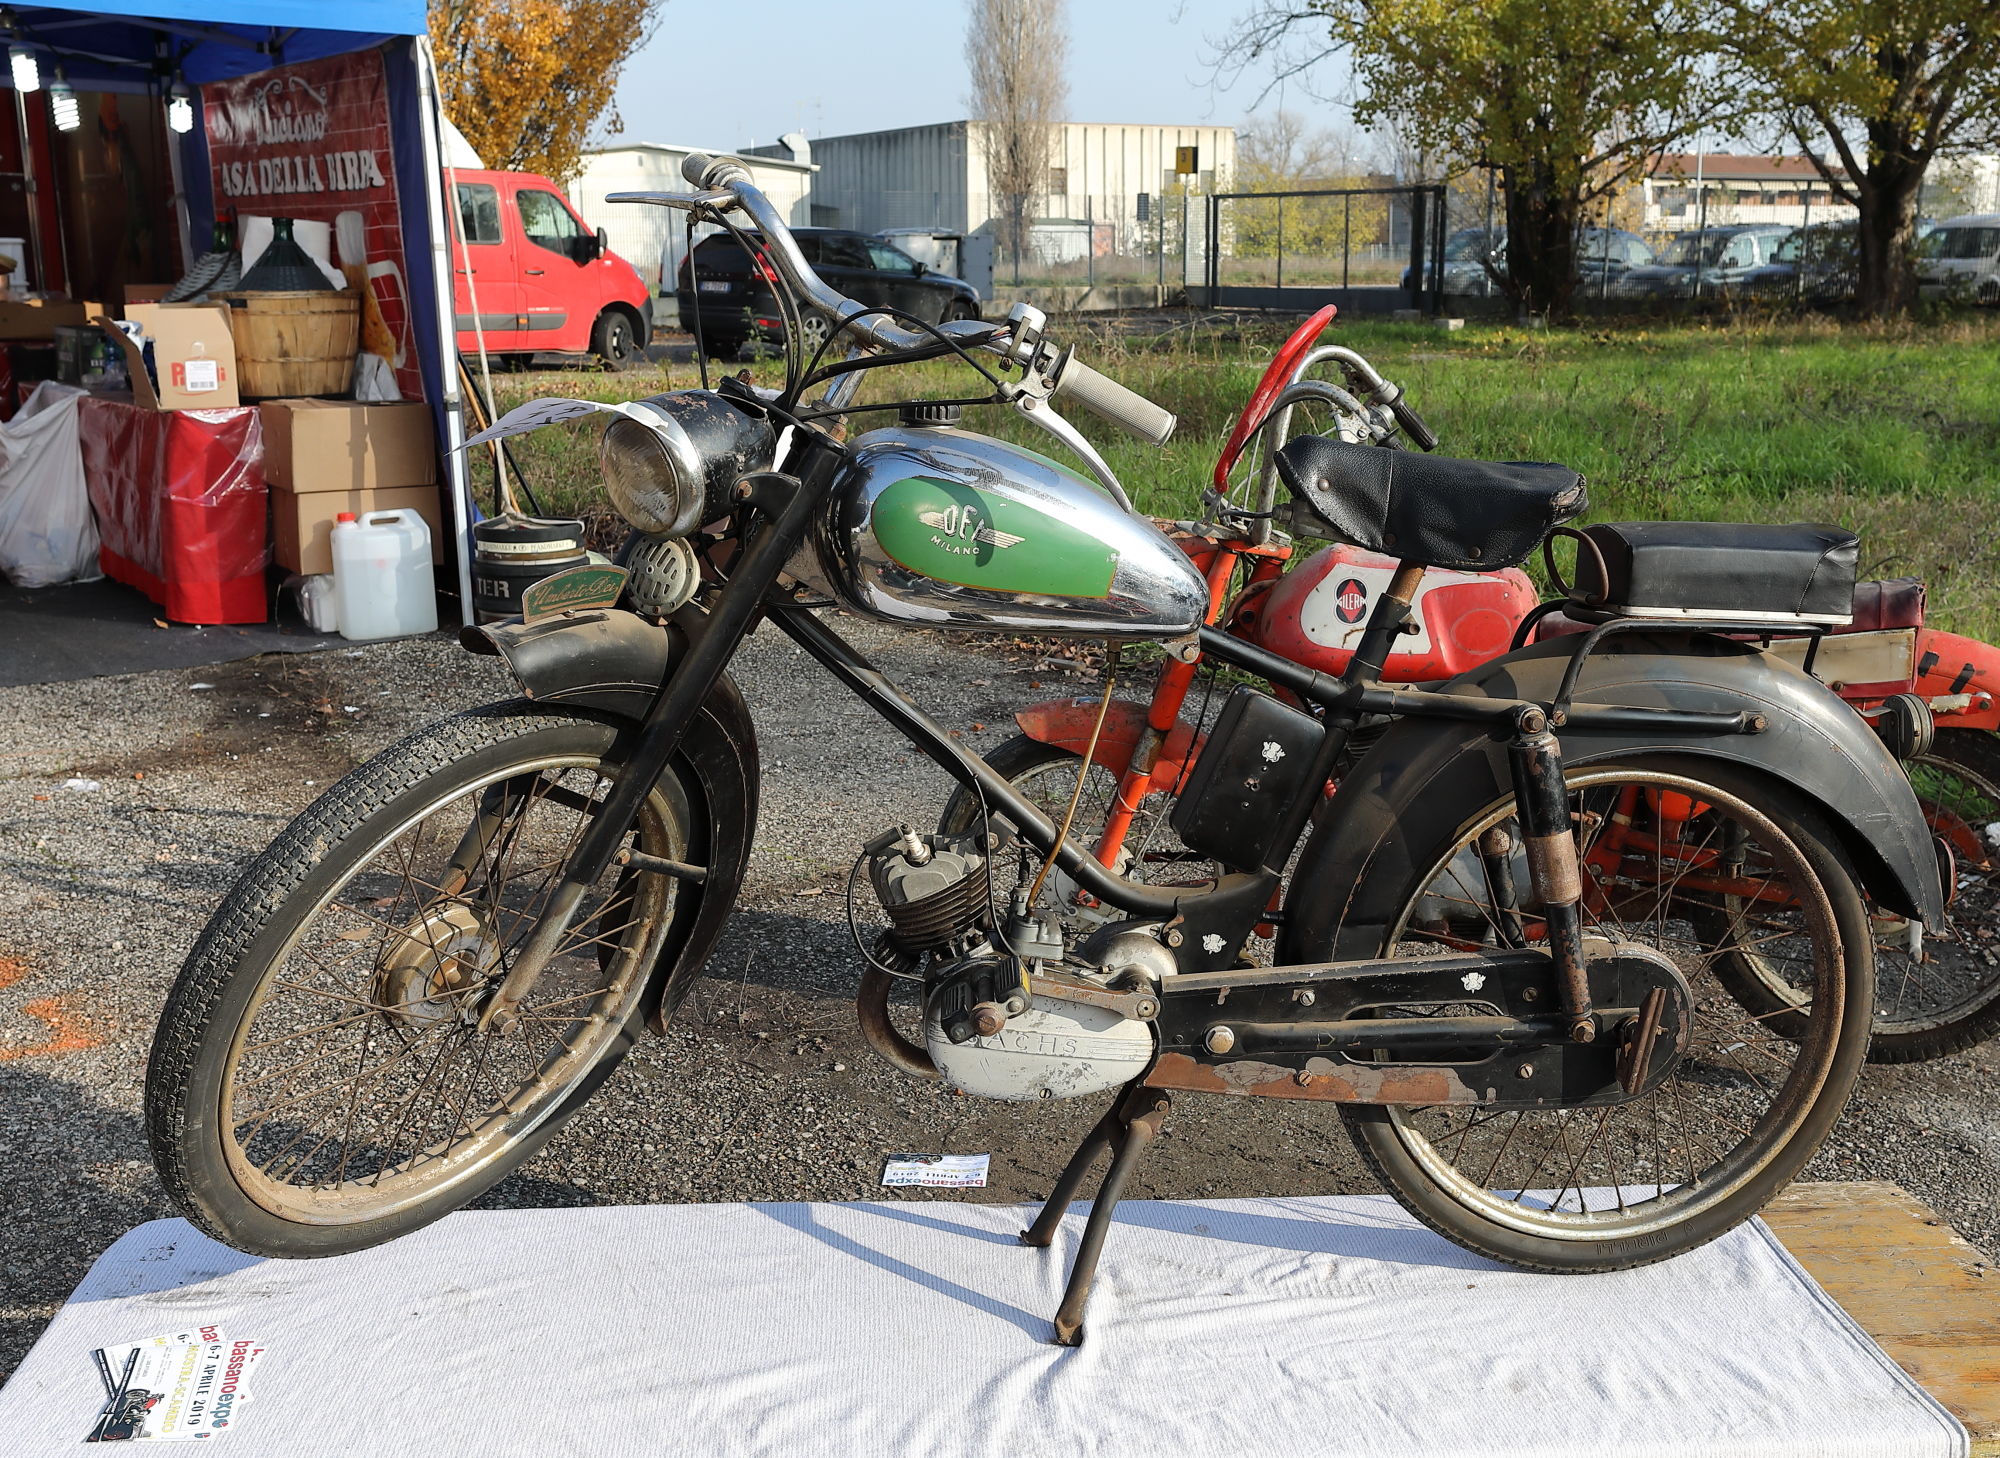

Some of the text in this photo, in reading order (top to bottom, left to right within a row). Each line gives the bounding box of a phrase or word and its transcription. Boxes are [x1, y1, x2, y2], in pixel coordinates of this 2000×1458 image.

[258, 154, 325, 195] DELLA
[930, 534, 980, 555] MILANO
[199, 1364, 216, 1396] APRILE
[187, 1399, 207, 1425] 2019
